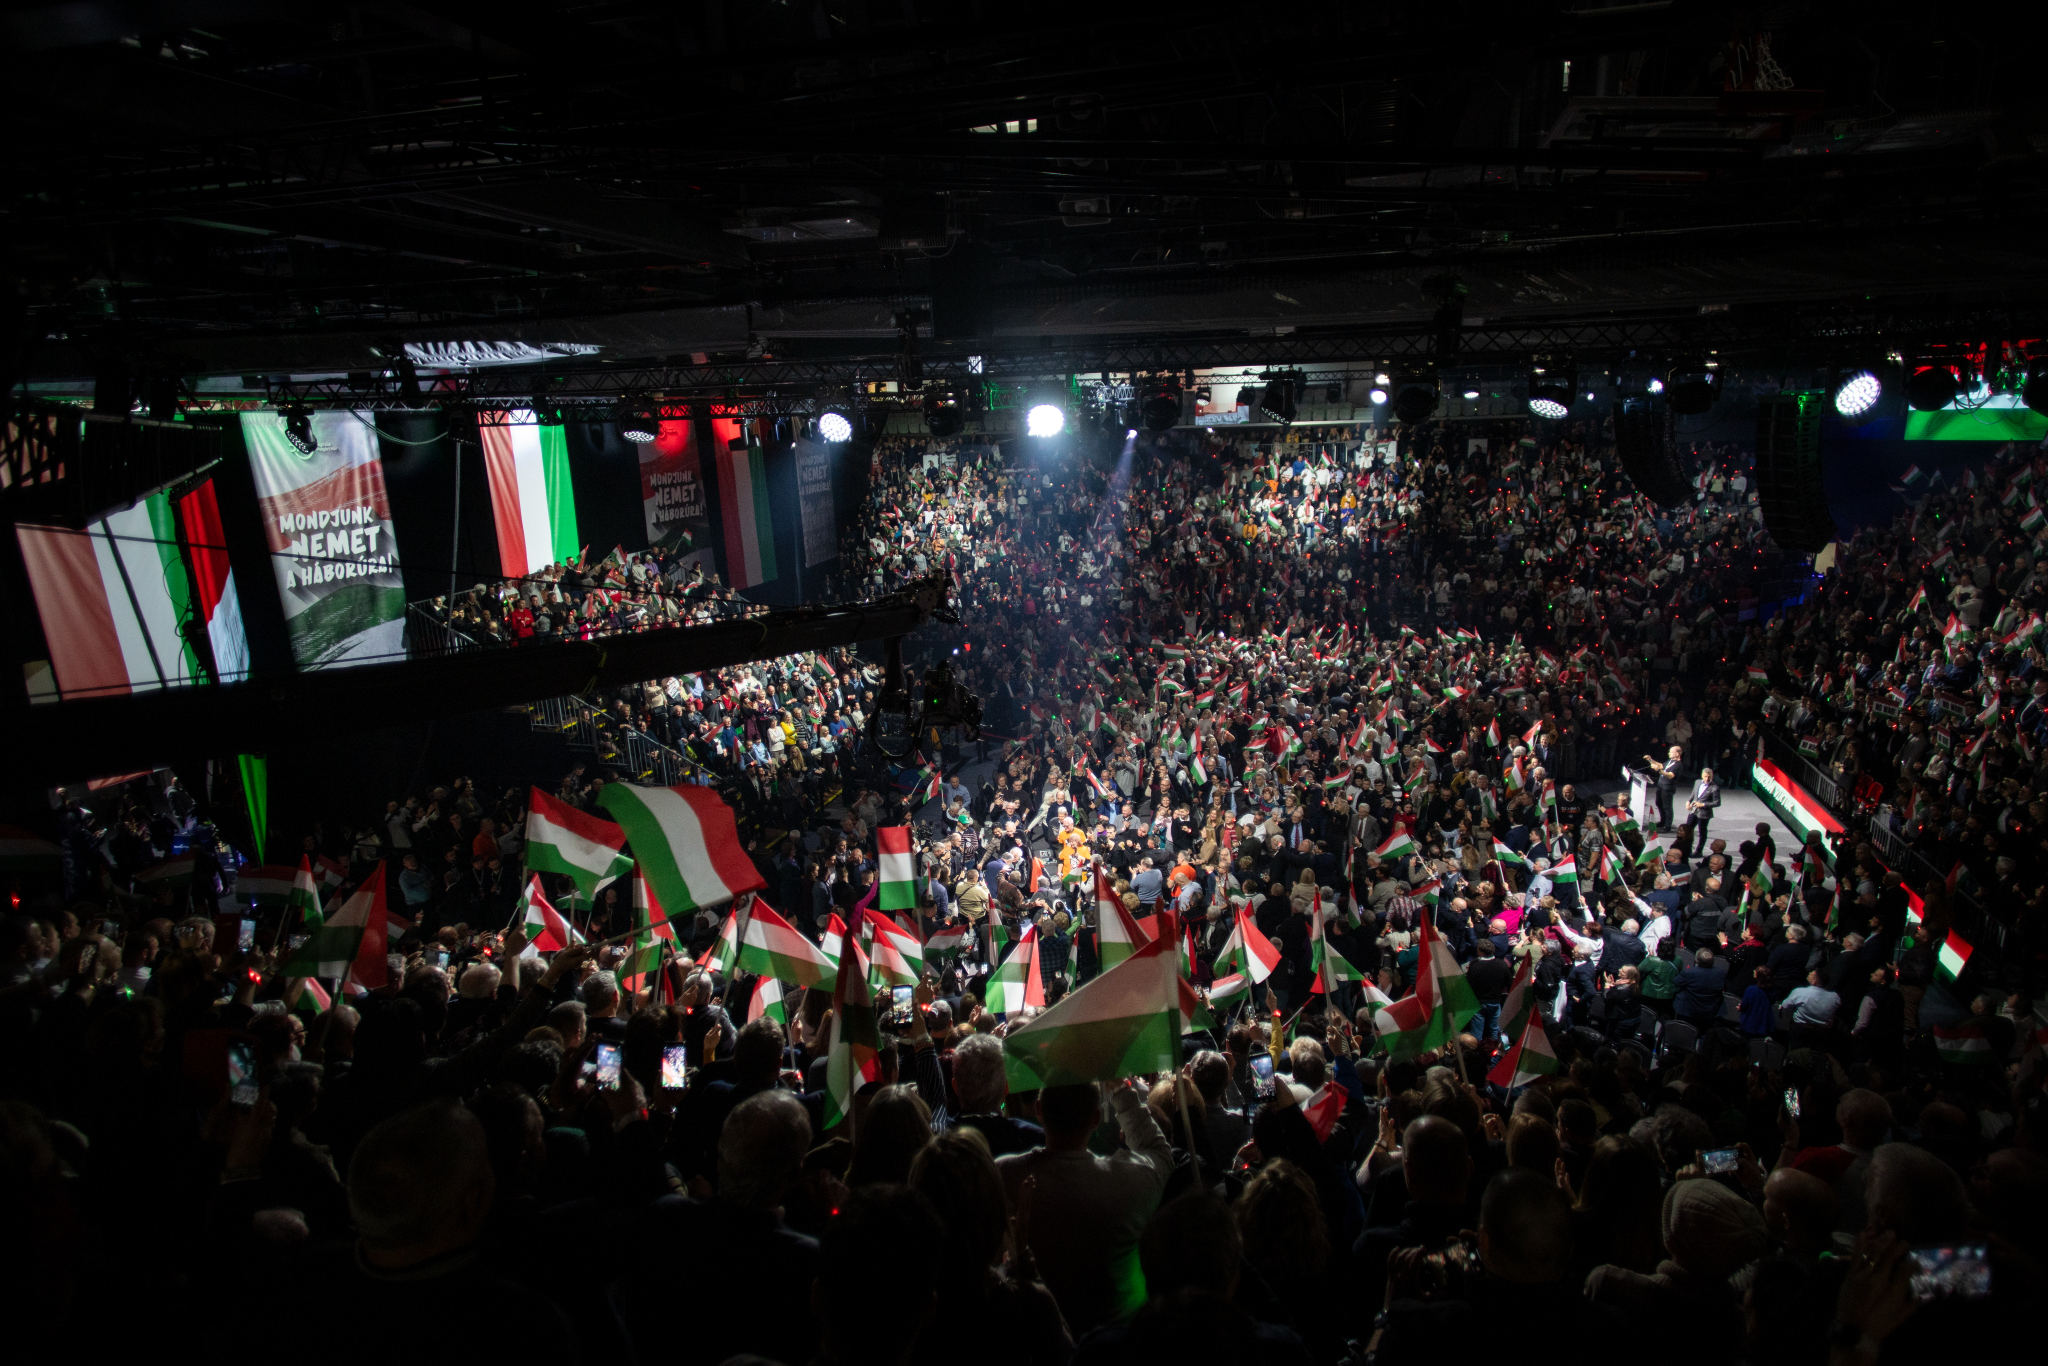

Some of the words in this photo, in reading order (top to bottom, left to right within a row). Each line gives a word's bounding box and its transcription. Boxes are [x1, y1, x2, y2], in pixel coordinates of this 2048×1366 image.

[650, 470, 692, 487] MONDJUNK
[803, 465, 827, 482] NEMET
[655, 483, 696, 507] NEMET
[280, 507, 373, 533] MONDJUNK
[651, 509, 658, 524] A
[659, 503, 703, 522] HÁBORÚRA!
[291, 525, 381, 562] NEMET
[287, 569, 296, 590] A
[302, 553, 393, 586] HÁBORÚRA!
[1875, 703, 1882, 711] NO
[1773, 787, 1794, 812] VIKTOR
